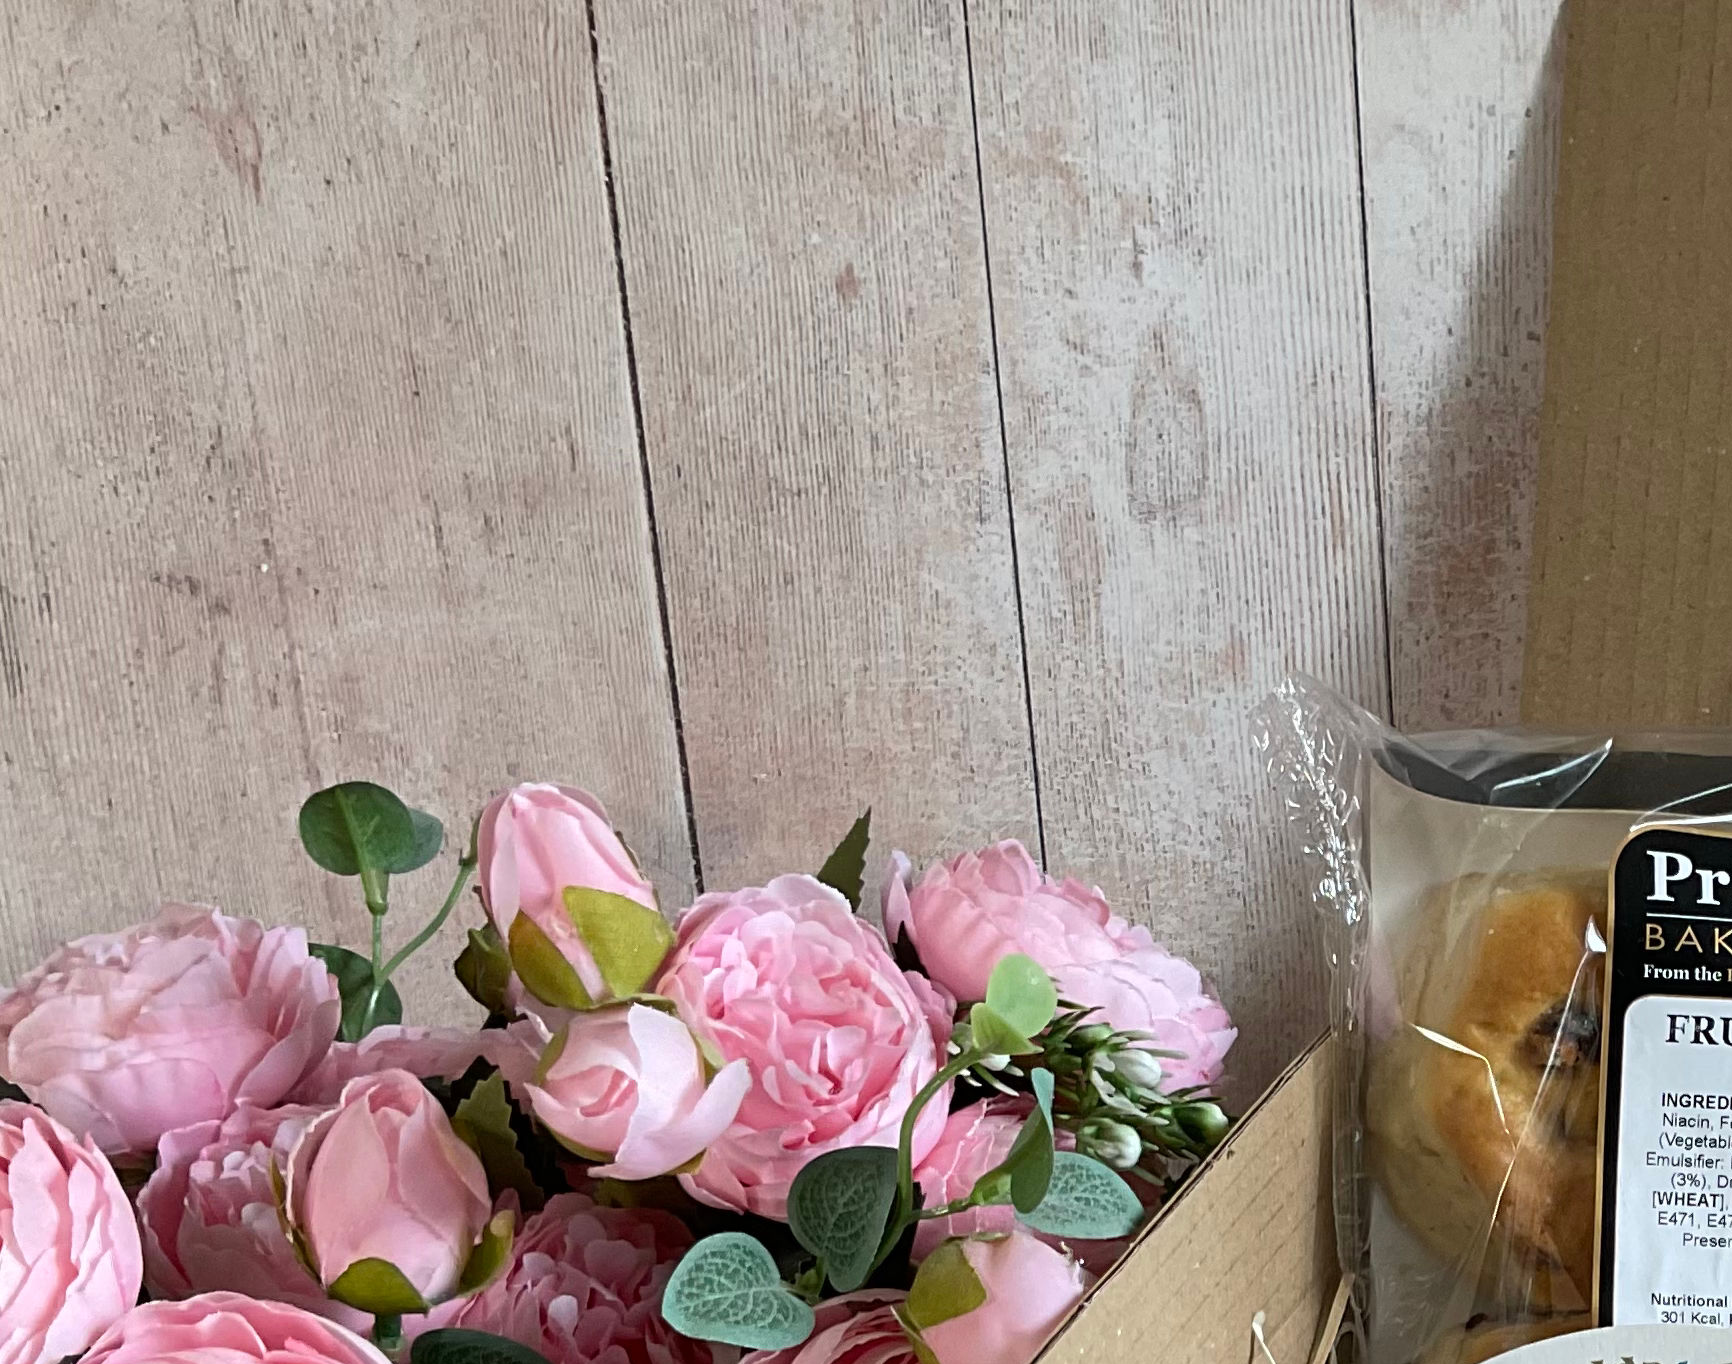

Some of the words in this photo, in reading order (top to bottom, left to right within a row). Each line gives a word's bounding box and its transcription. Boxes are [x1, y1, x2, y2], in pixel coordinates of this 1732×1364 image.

[1643, 963, 1690, 981] From
[1694, 965, 1722, 983] the
[1662, 1112, 1714, 1132] Niacin,
[1645, 1151, 1725, 1171] Emulsifier:
[1670, 1172, 1711, 1191] (3%),
[1652, 1190, 1729, 1212] [WHEAT],
[1657, 1210, 1701, 1230] E471,
[1650, 1292, 1728, 1309] Nutritional
[1660, 1310, 1687, 1325] 301
